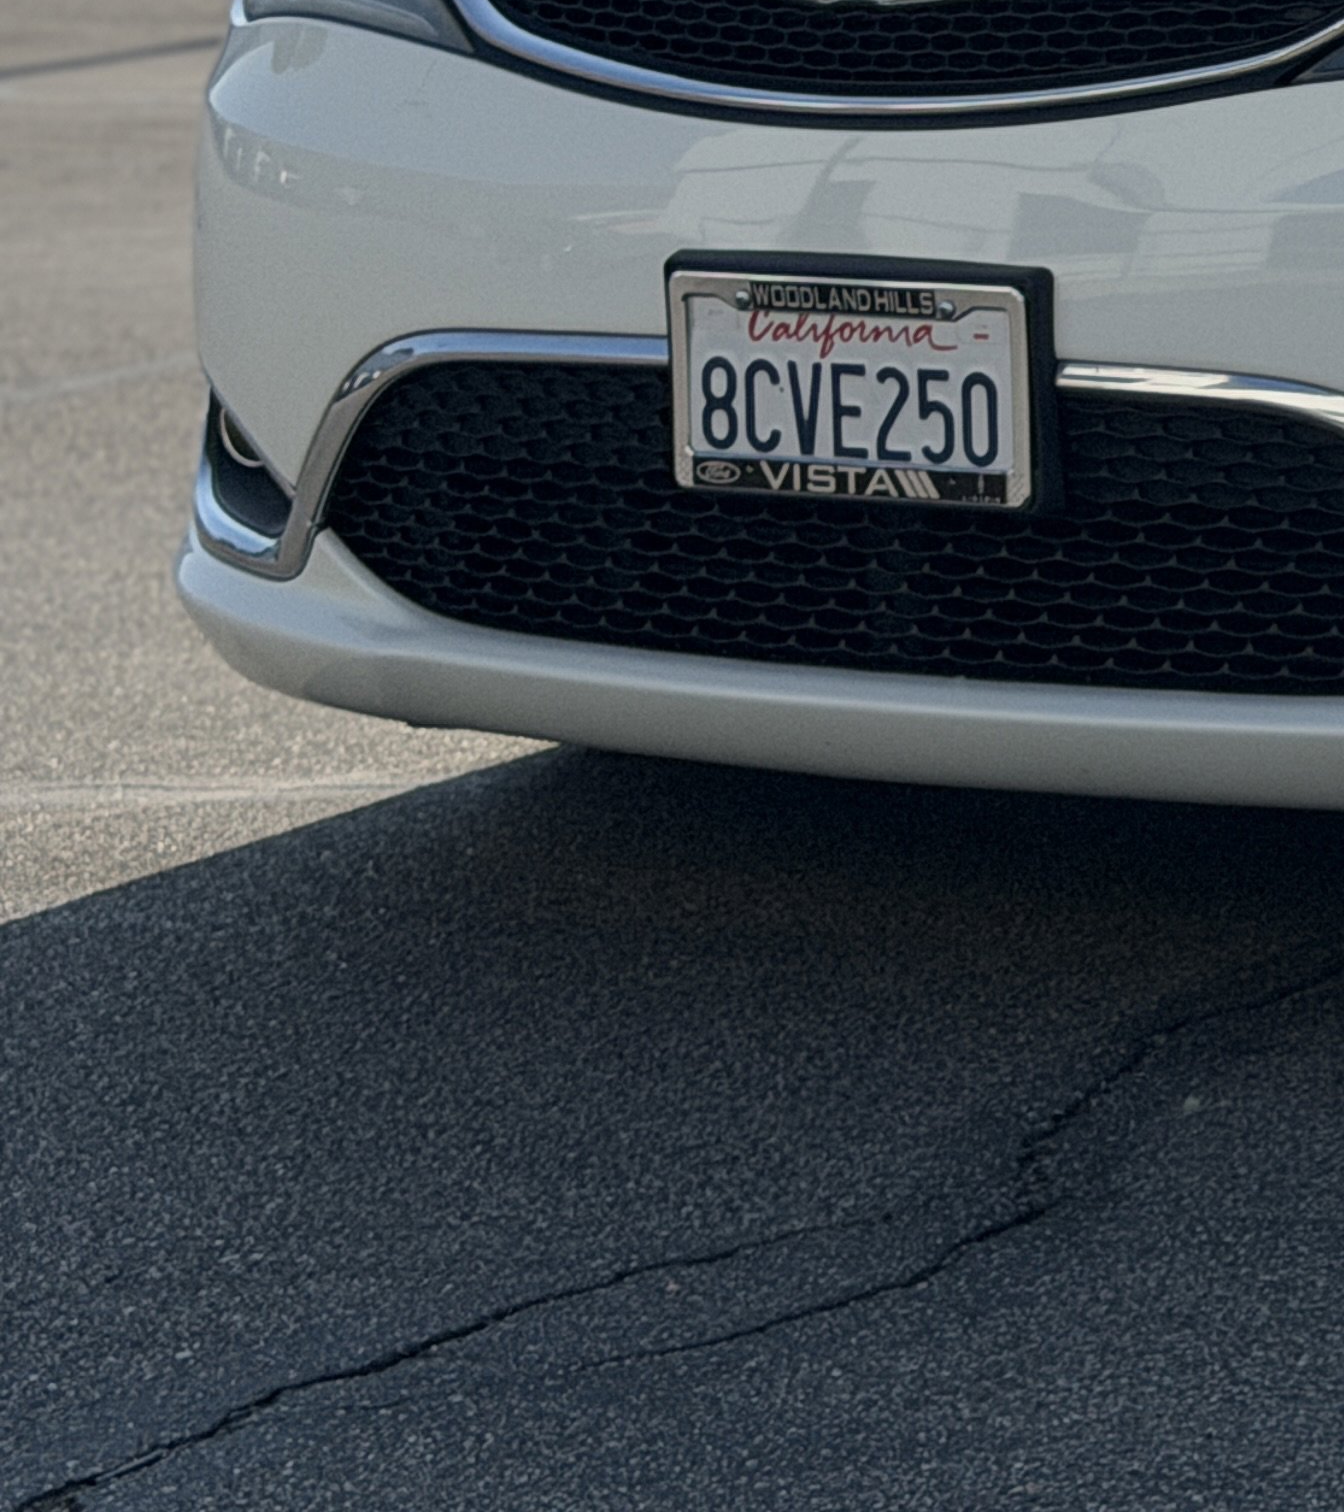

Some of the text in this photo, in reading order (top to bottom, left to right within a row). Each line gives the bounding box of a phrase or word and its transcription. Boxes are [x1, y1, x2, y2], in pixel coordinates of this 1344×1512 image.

[753, 284, 935, 316] WOODLAND HILLS
[747, 311, 958, 359] California
[701, 355, 999, 468] 8CVE250
[759, 460, 900, 498] VISTA
